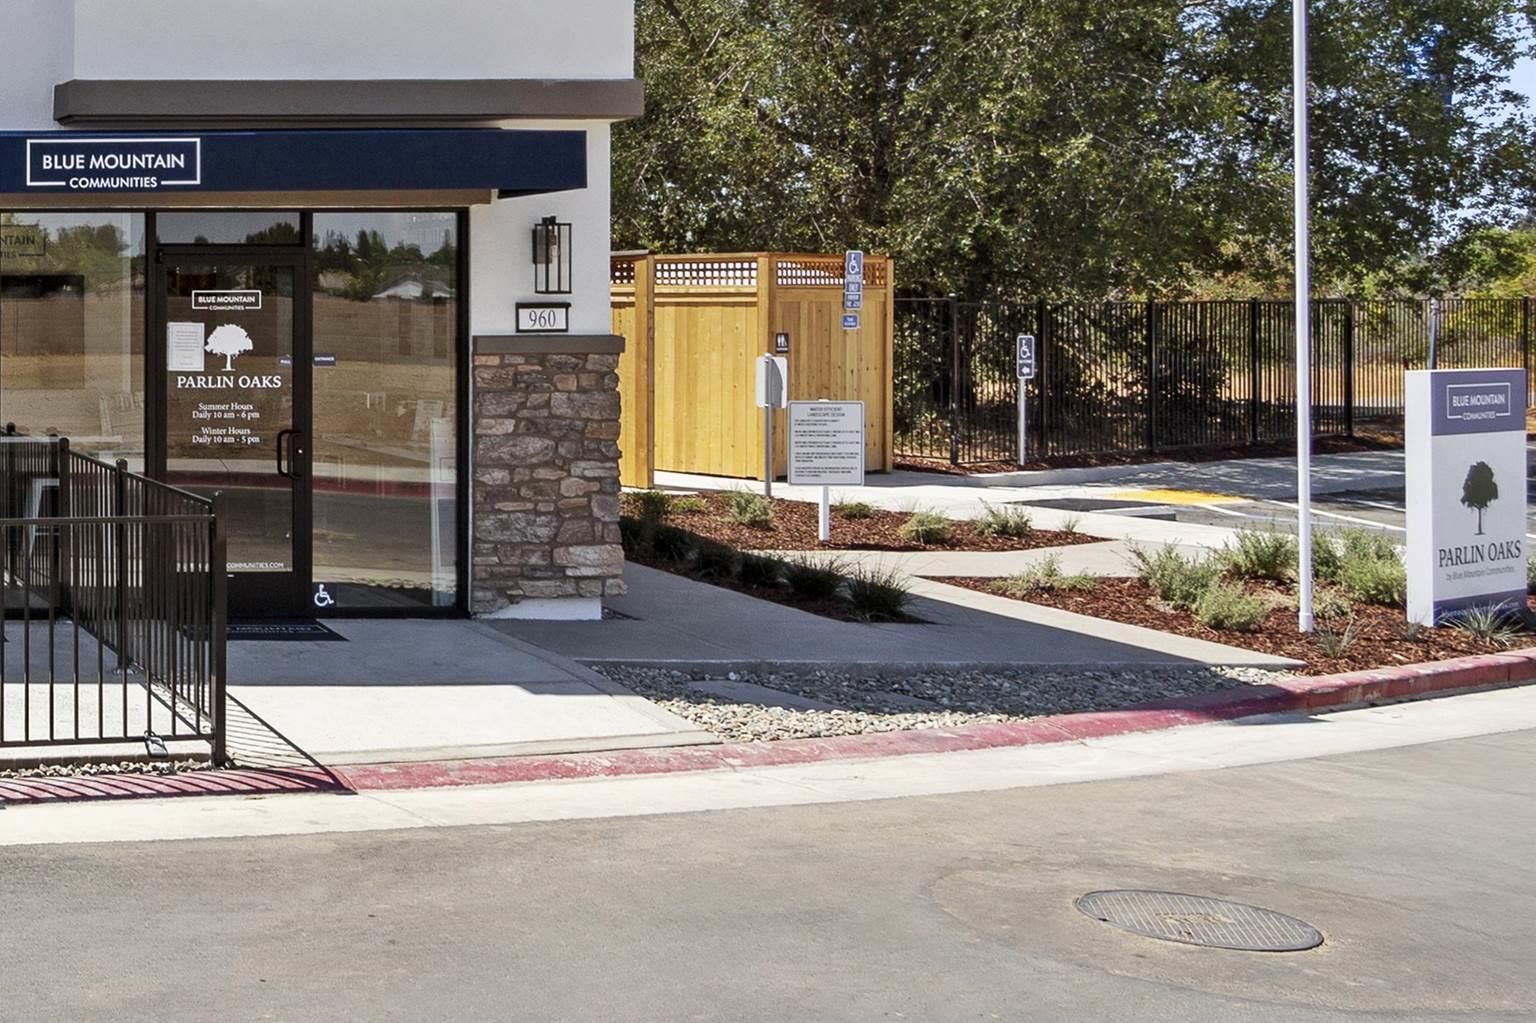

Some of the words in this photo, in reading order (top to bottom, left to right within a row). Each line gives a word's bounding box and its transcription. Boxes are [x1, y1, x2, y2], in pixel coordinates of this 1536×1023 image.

[42, 155, 85, 169] BLUE
[89, 154, 185, 169] MOUNTAIN
[69, 177, 157, 188] COMMUNITIES
[529, 310, 556, 327] 960
[177, 376, 234, 388] PARLIN
[239, 376, 281, 388] OAKS
[231, 402, 253, 410] Hours
[1453, 396, 1469, 407] BLUE
[1471, 394, 1505, 405] MOUNTAIN
[192, 411, 211, 420] Daily
[192, 435, 211, 444] Daily
[1439, 545, 1484, 567] PARLIN
[1488, 540, 1521, 561] OAKS
